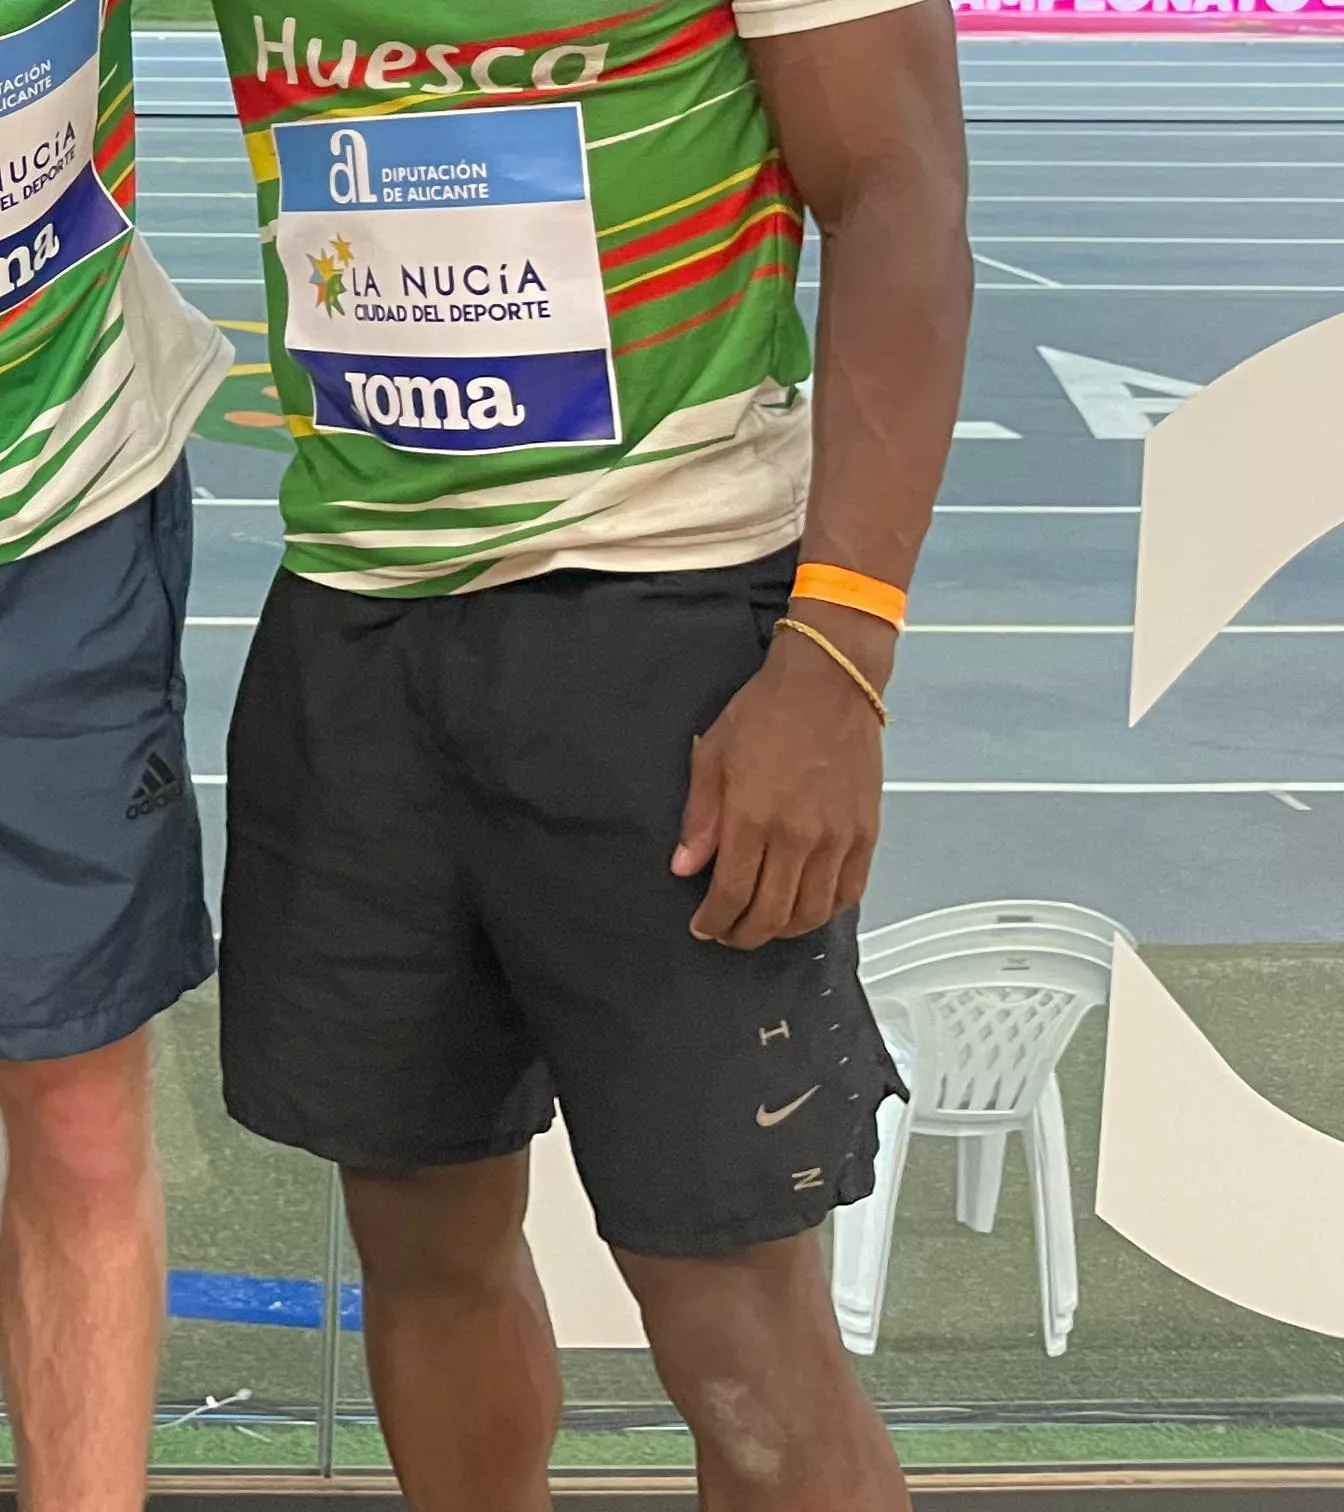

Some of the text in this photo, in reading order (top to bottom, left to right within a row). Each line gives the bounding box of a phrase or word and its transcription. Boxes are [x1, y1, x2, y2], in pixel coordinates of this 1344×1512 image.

[253, 15, 610, 94] Huesca
[23, 144, 76, 201] DEPORTE
[382, 159, 487, 182] DIPUTACIÓN
[383, 183, 490, 202] DE ALICANTE
[352, 266, 381, 297] LA
[354, 300, 552, 322] CIUDAD DEL DEPORTE
